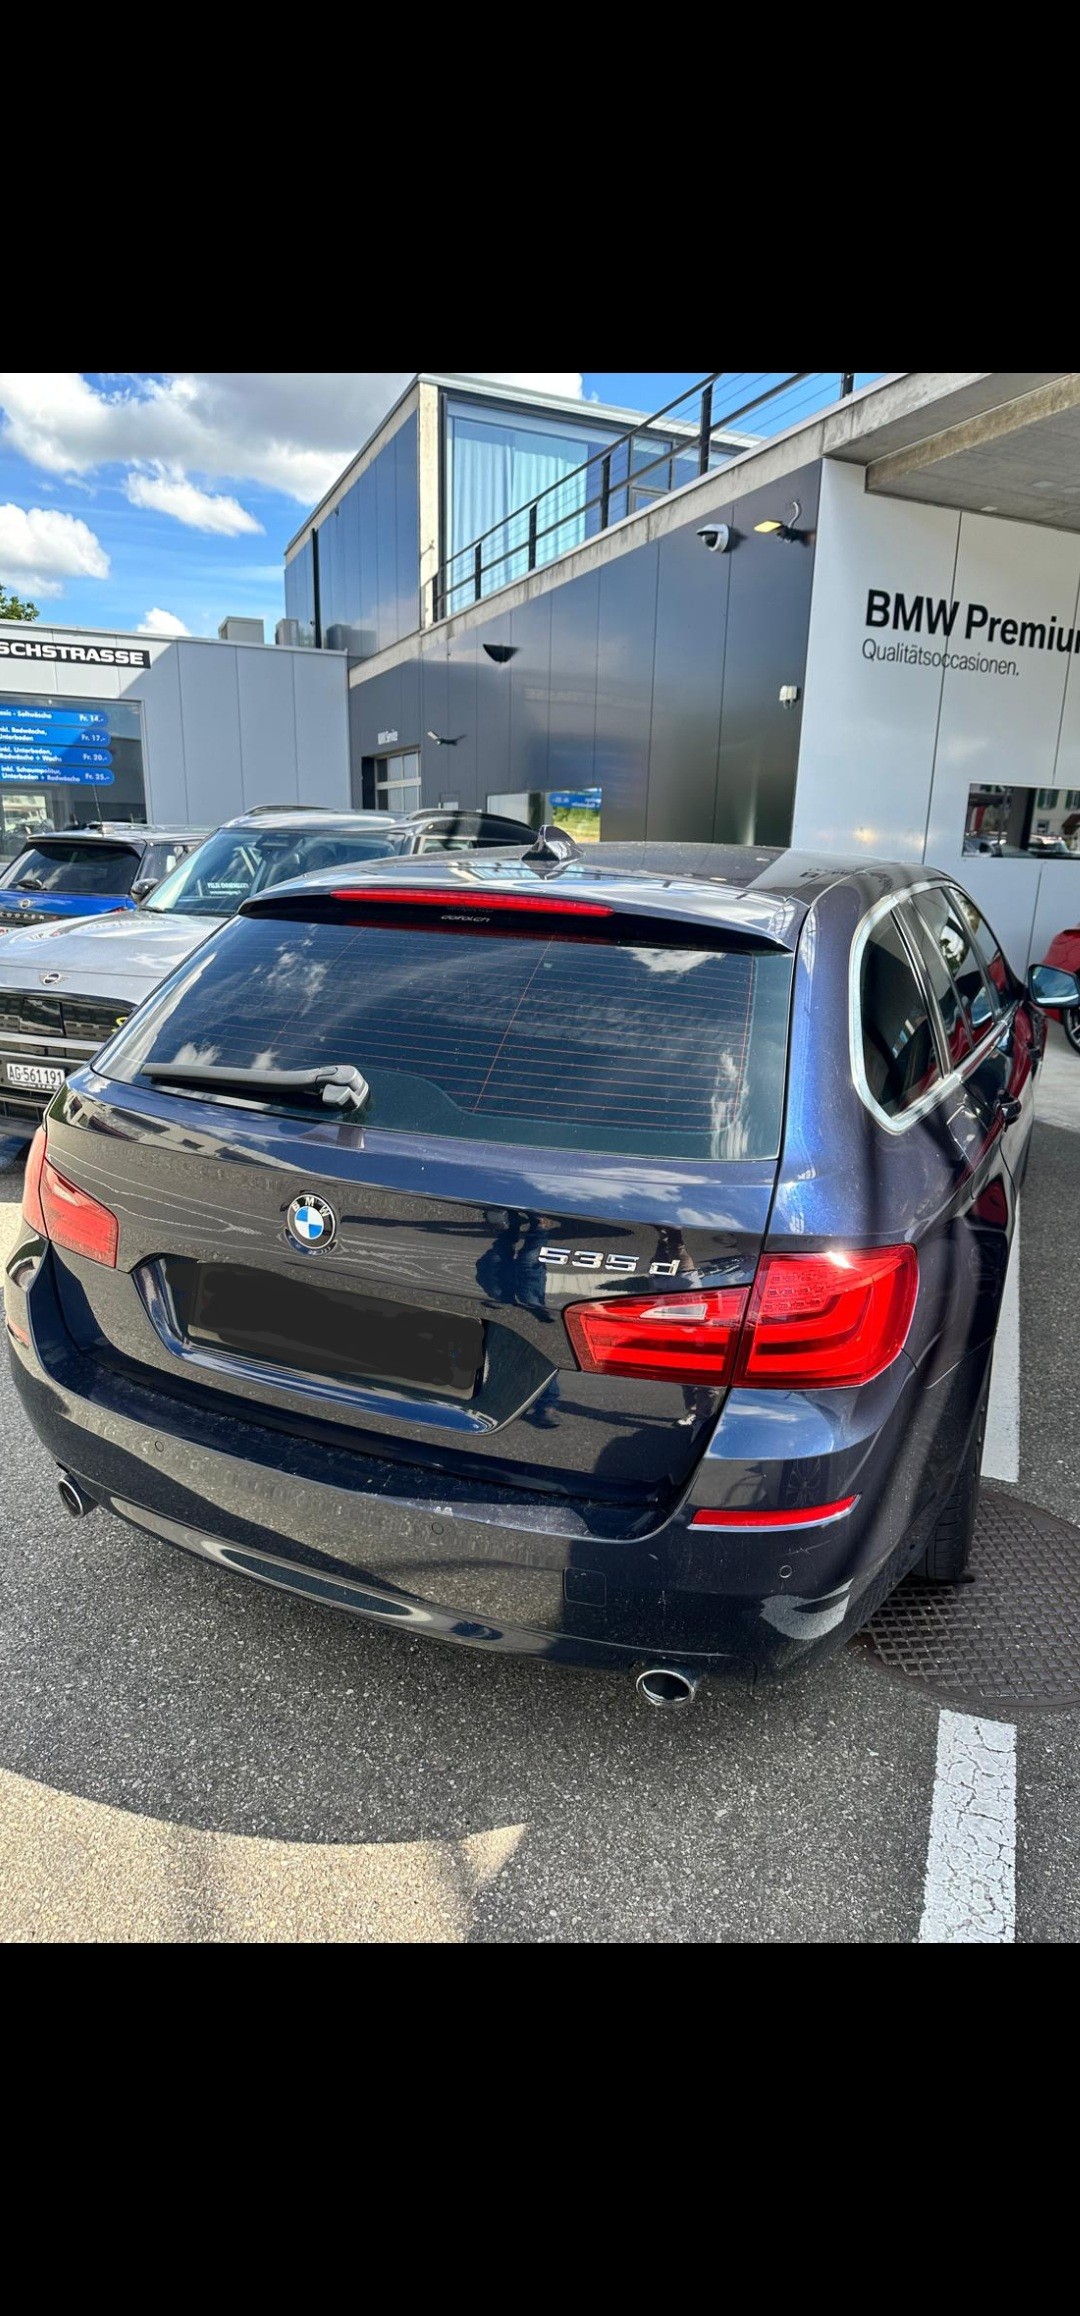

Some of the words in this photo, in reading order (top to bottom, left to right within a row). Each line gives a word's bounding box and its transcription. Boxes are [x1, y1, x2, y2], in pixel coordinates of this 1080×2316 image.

[865, 588, 960, 636] BMW
[965, 603, 1080, 654] Premiu
[0, 641, 144, 665] SCHSTRASSE
[862, 638, 1019, 676] Qualitätsoccasionen.
[291, 1196, 331, 1217] BMW
